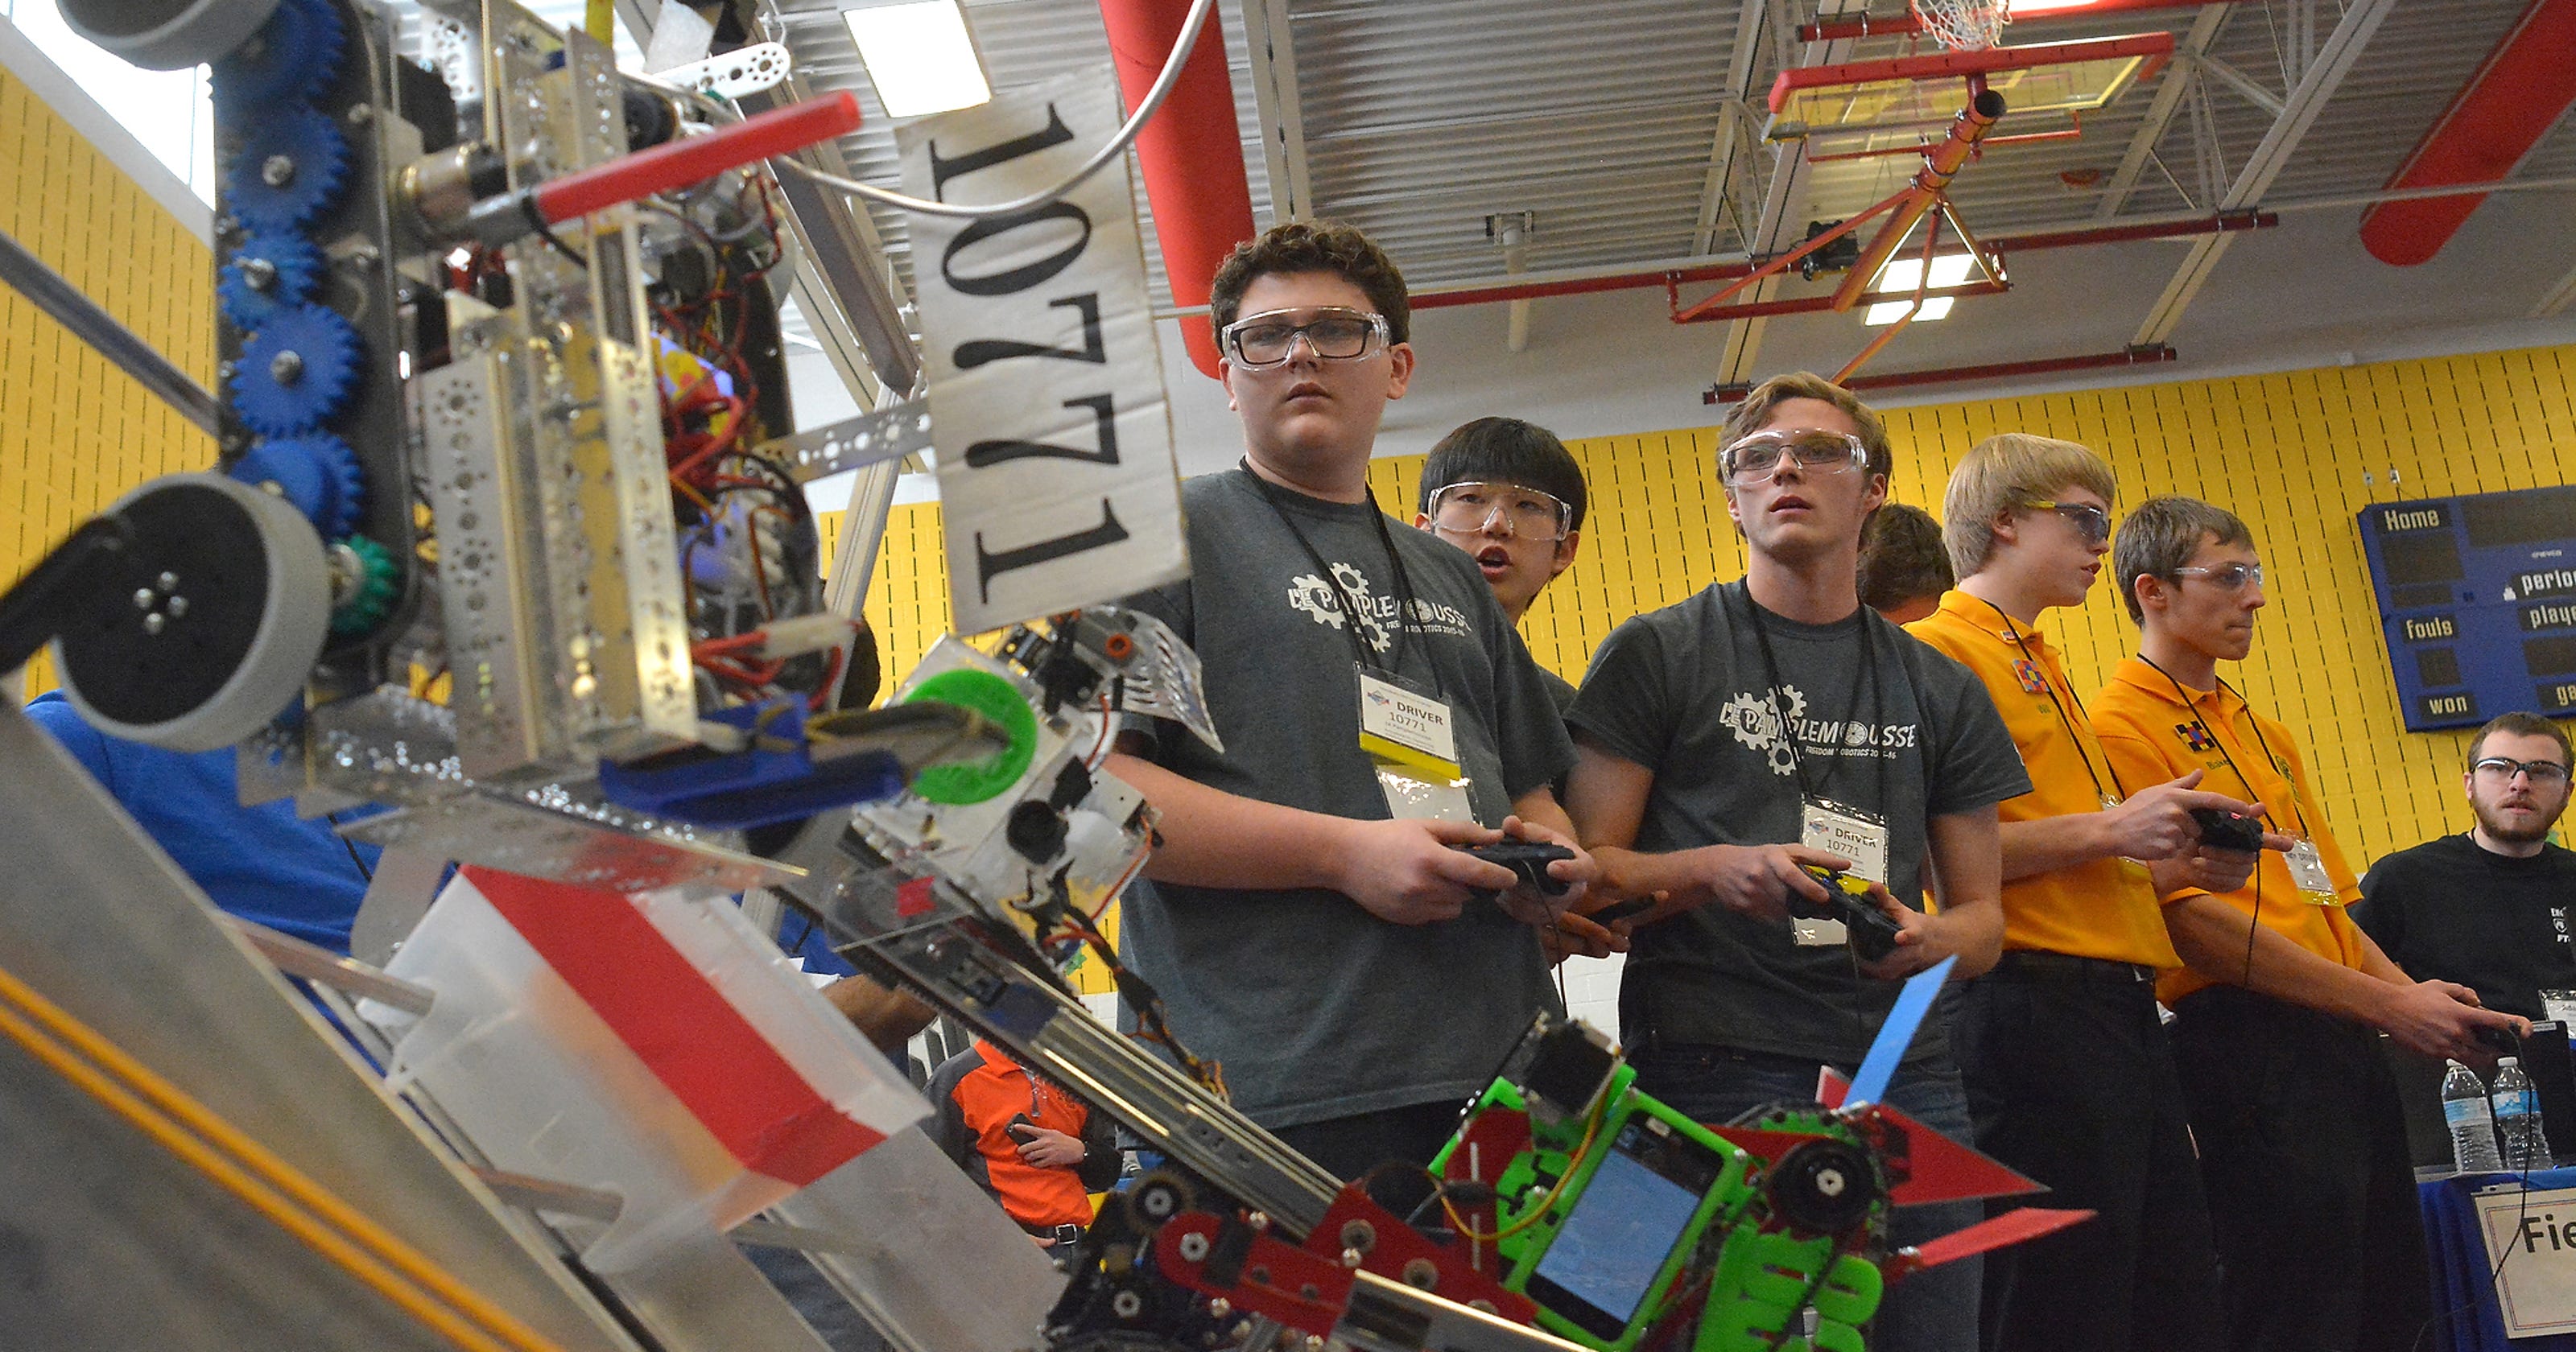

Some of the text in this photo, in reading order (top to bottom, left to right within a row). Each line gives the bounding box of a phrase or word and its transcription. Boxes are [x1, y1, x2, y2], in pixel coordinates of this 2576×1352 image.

[929, 102, 1129, 604] 10771
[2384, 509, 2440, 530] Home
[1397, 702, 1443, 726] DRIVER
[2429, 696, 2467, 714] won
[1389, 711, 1426, 733] 10771
[1835, 748, 1869, 757] OBOTICS
[1827, 839, 1860, 857] 10771
